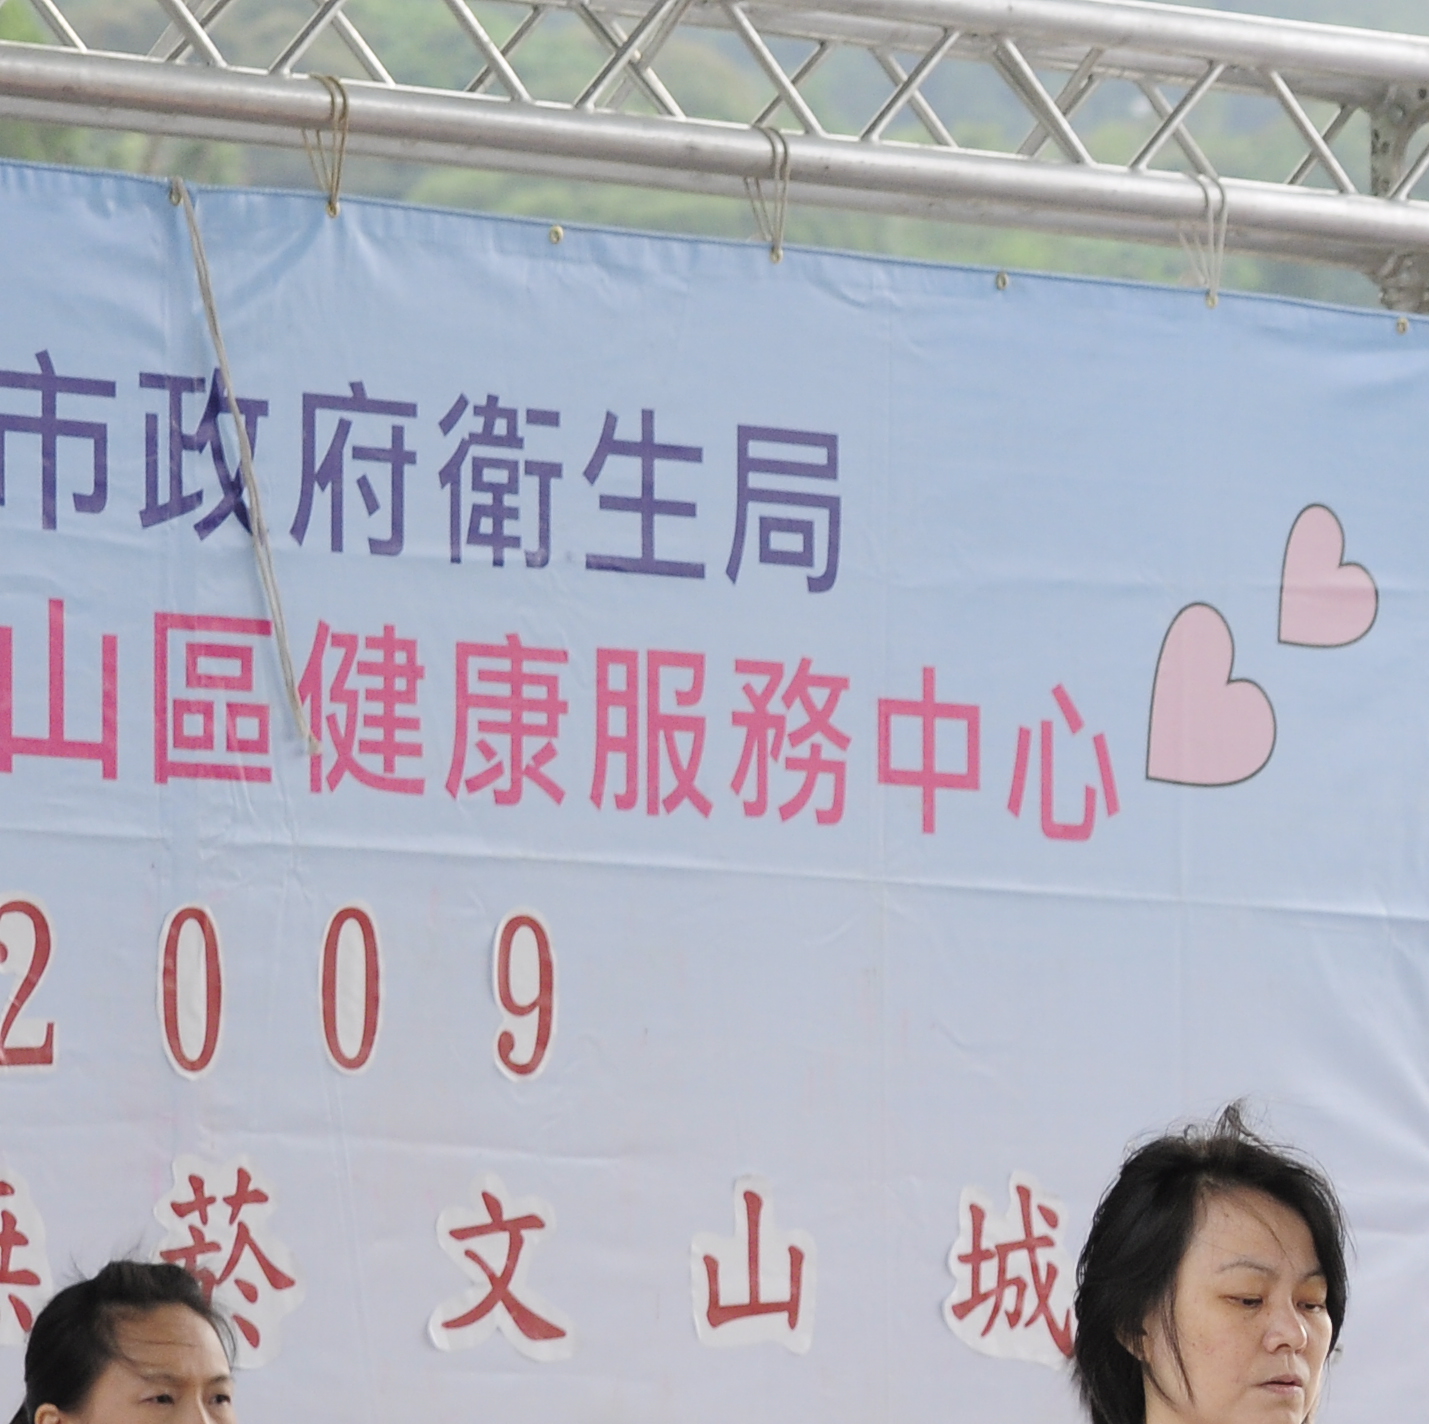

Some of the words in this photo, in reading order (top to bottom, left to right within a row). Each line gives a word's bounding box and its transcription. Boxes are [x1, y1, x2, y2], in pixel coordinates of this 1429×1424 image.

[0, 350, 842, 594] 市政府衛生局
[0, 598, 1120, 842] 山區健康服務中心
[0, 900, 554, 1075] 2009
